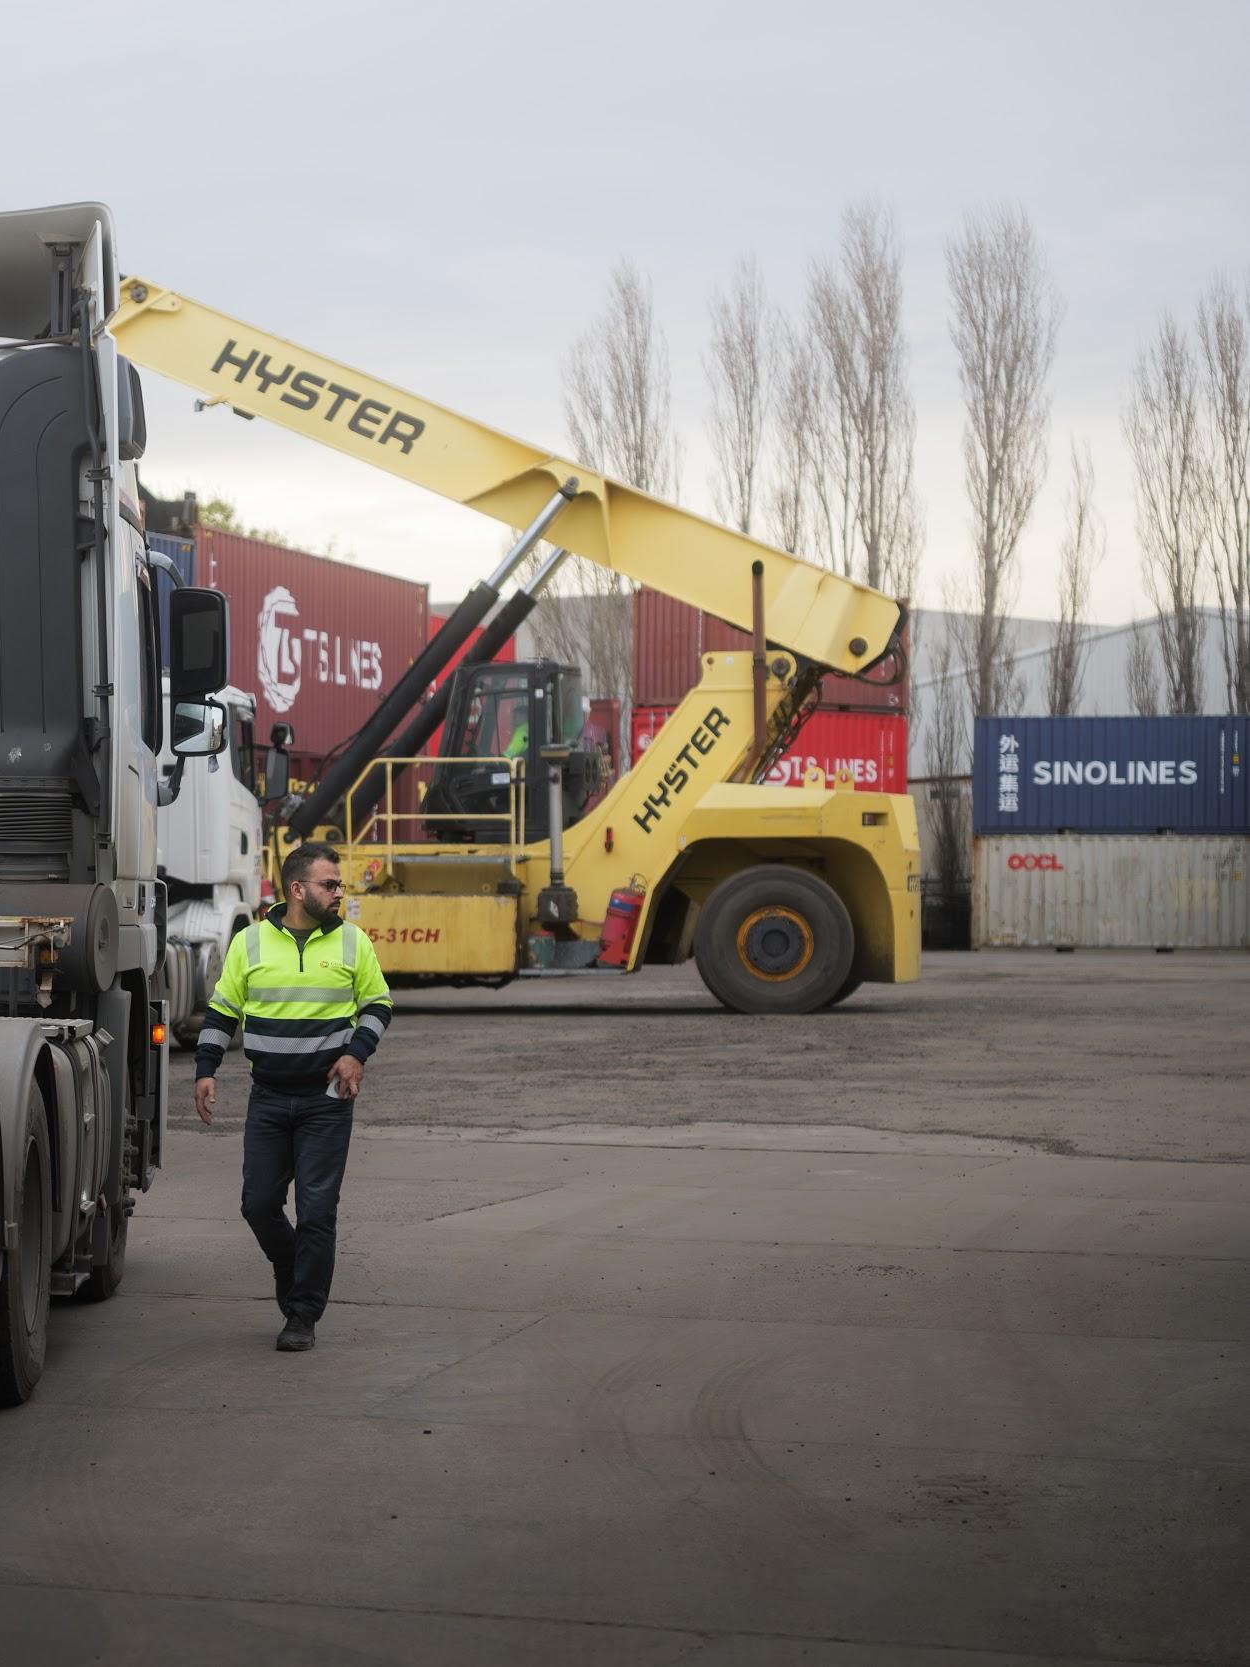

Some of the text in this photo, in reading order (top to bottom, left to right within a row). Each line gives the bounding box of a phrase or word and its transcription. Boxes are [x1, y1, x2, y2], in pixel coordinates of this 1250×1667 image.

[209, 338, 426, 455] HYSTER
[633, 706, 731, 834] HYSTER
[1033, 760, 1198, 785] SINOLINES
[1007, 854, 1065, 872] OOCL
